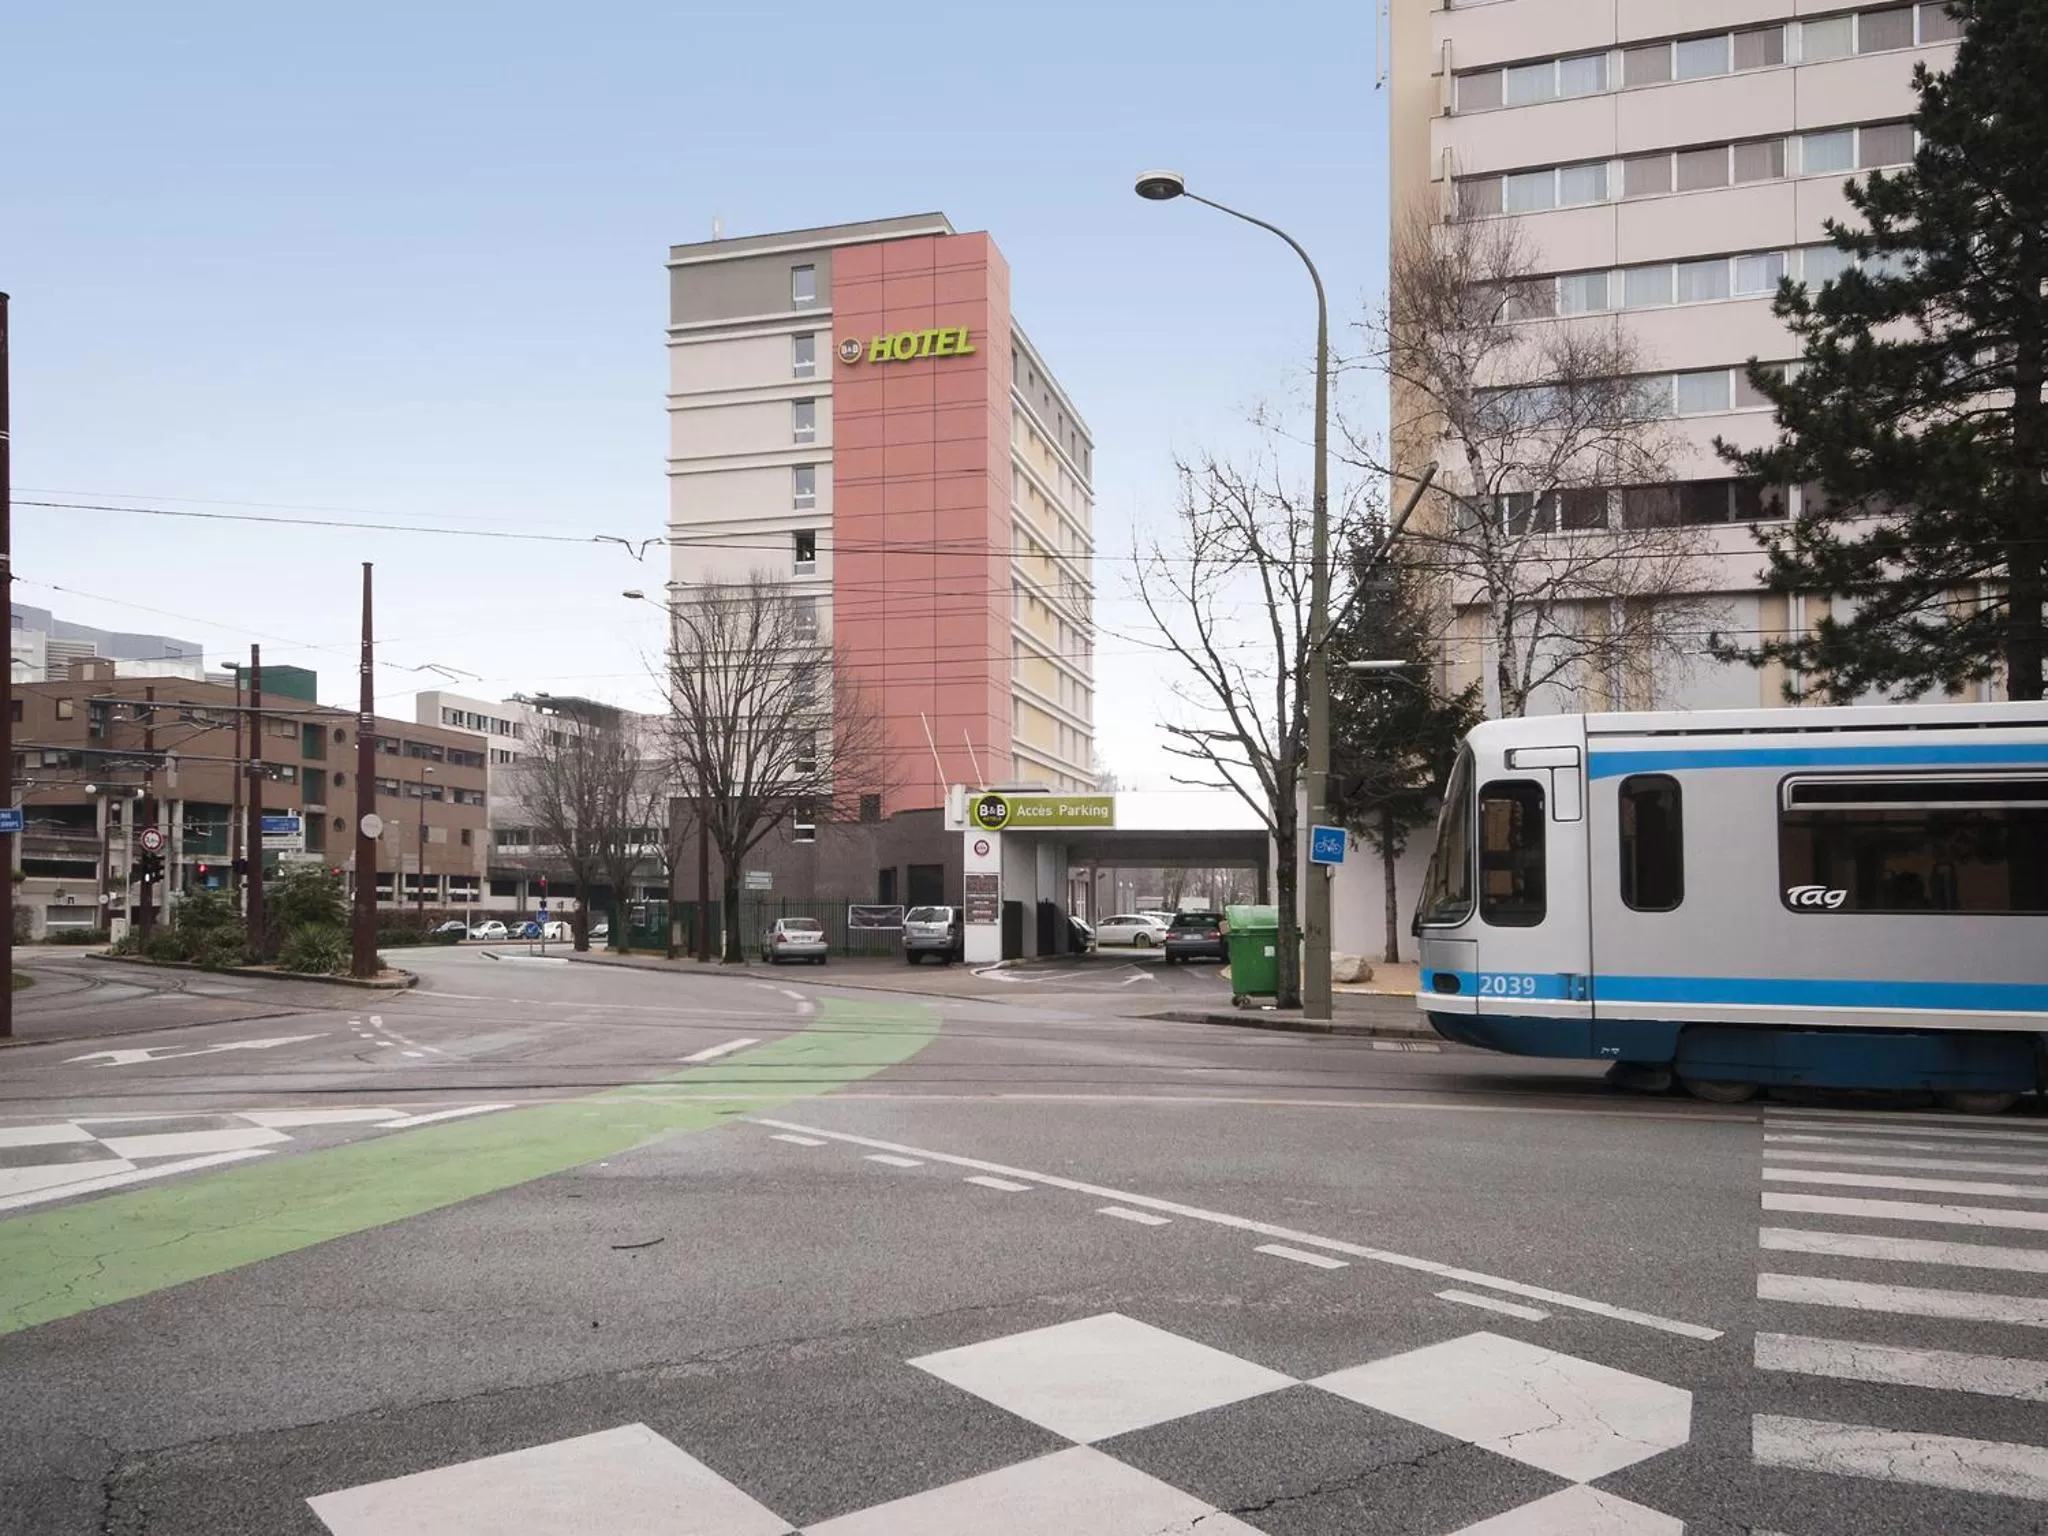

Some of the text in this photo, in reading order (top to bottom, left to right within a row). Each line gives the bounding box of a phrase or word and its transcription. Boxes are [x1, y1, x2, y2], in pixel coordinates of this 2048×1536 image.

[868, 325, 976, 363] HOTEL
[979, 804, 1109, 818] B&B Accès Parking
[1787, 885, 1848, 909] Tag
[1480, 975, 1537, 995] 2039
